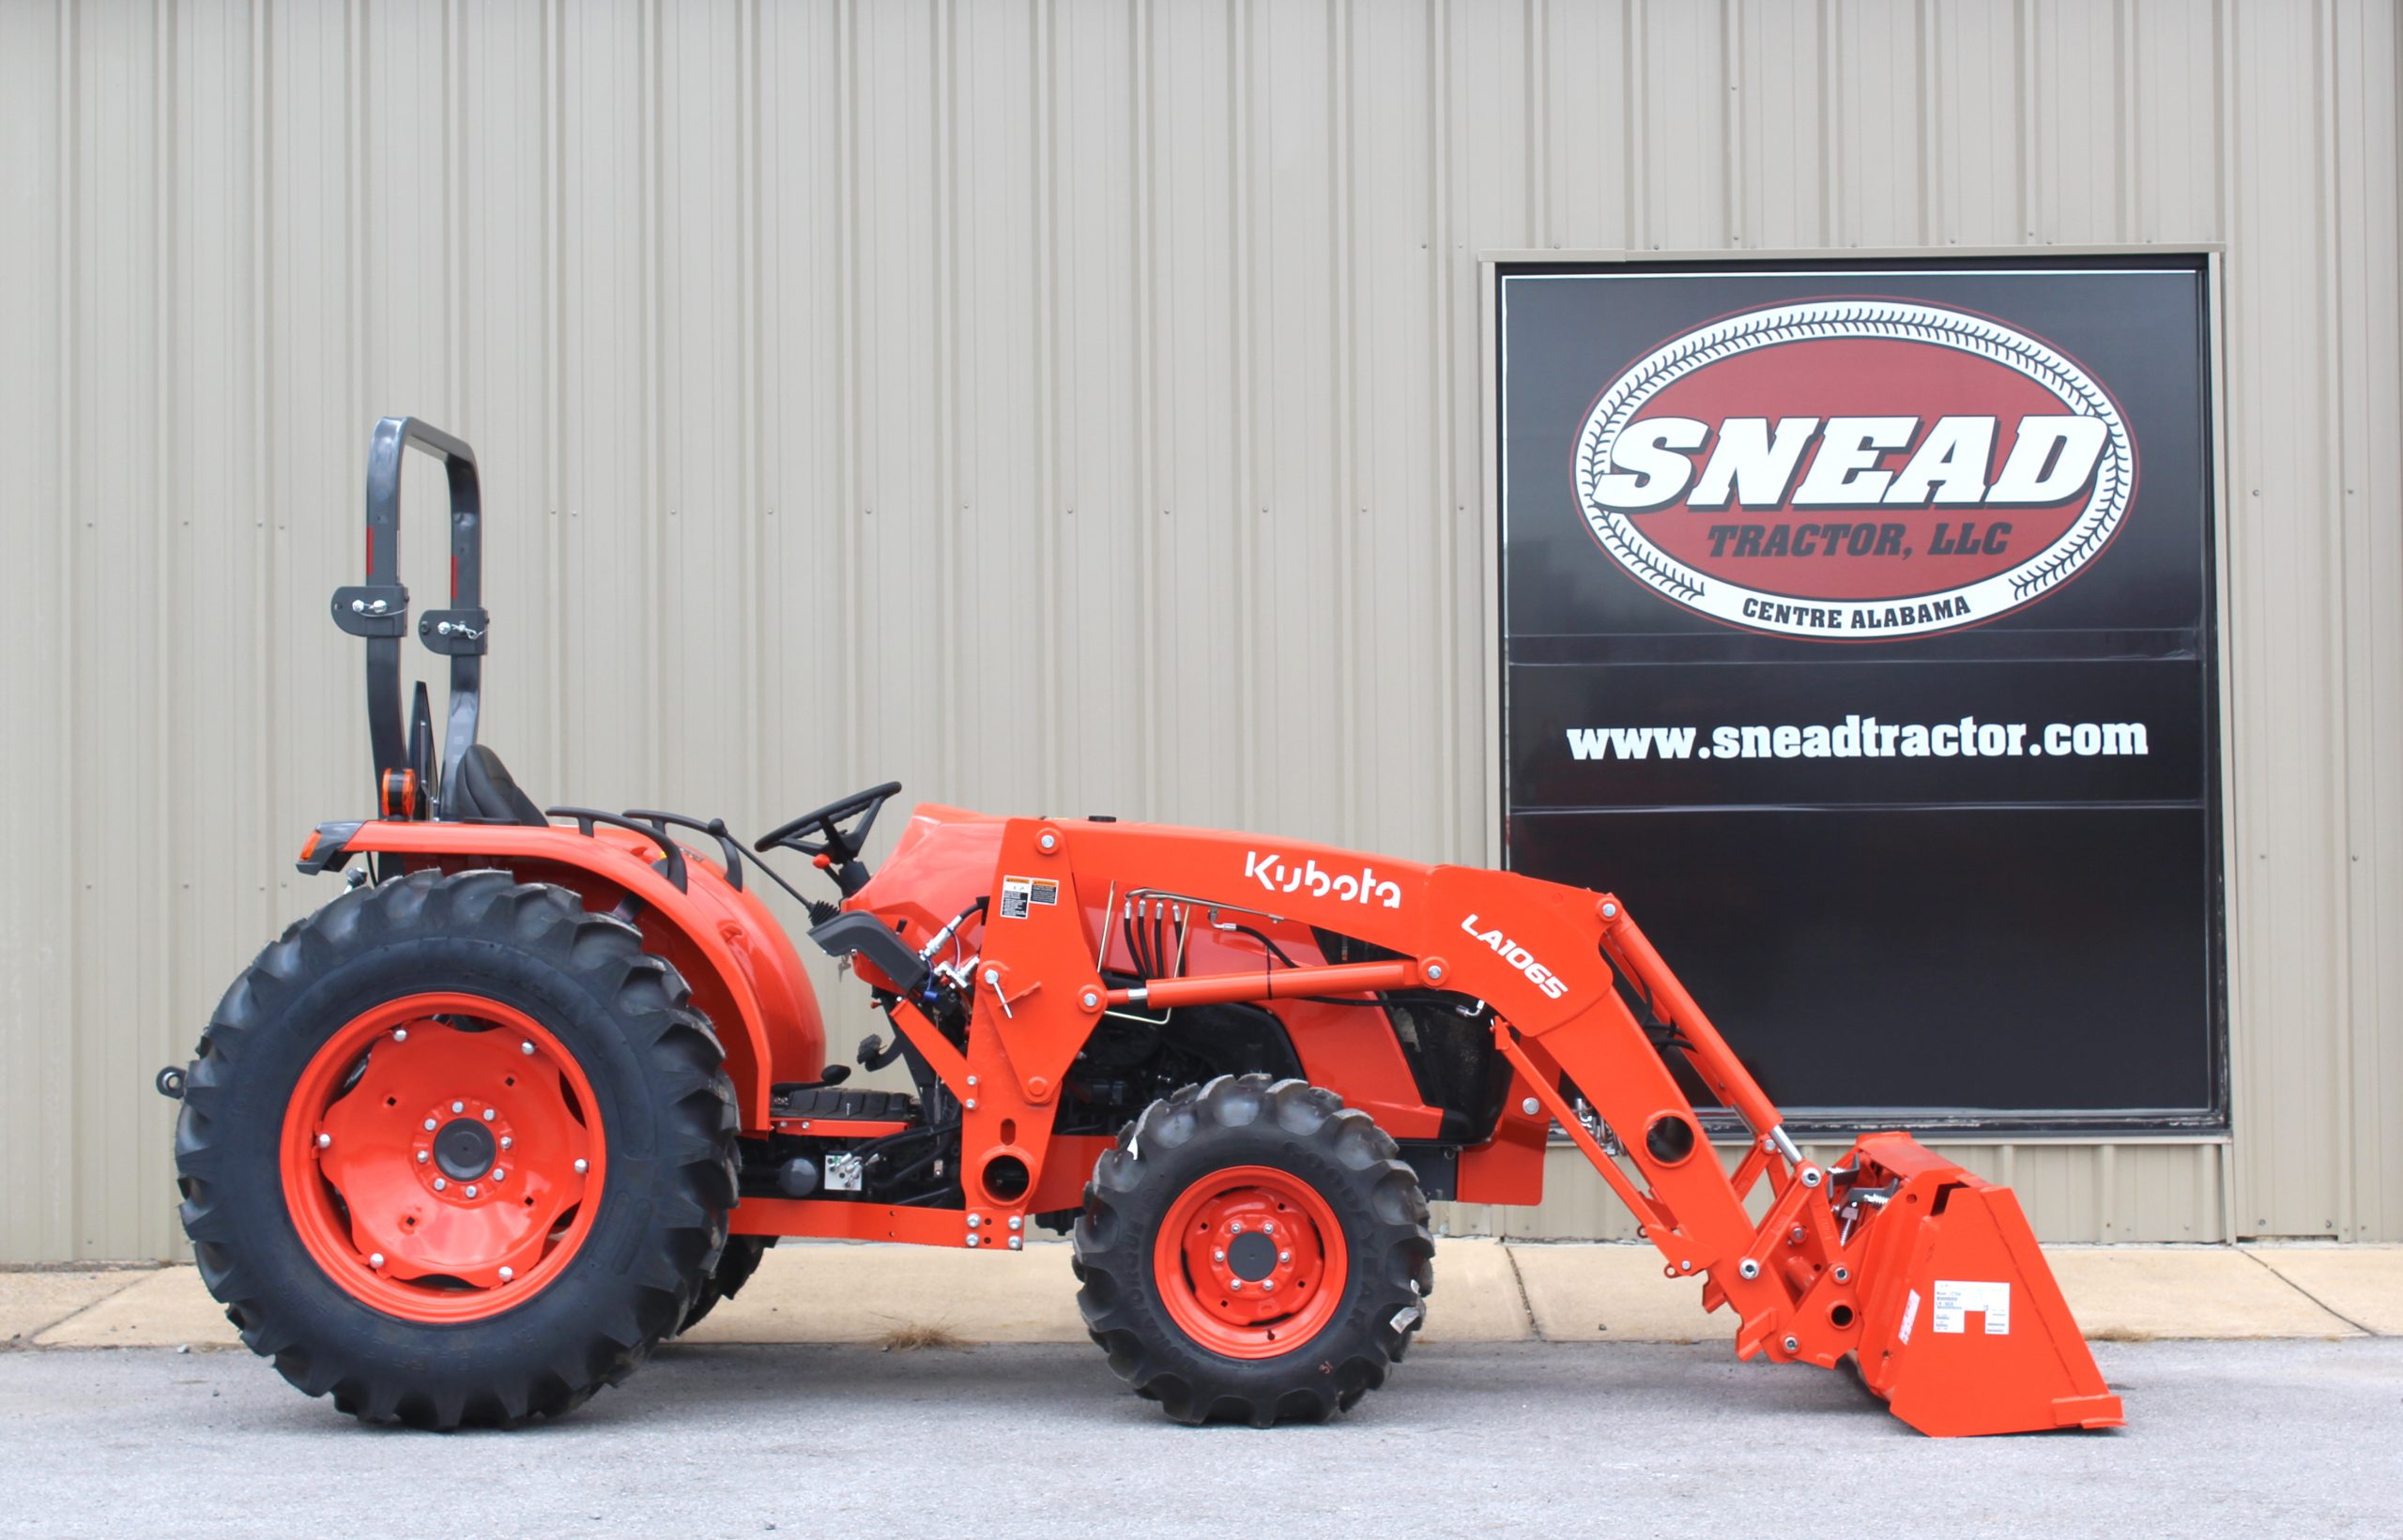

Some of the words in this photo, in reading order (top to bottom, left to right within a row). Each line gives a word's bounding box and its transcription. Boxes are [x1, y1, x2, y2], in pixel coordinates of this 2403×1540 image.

[1591, 415, 2108, 510] SNEAD
[1707, 523, 1913, 559] TRACTOR,
[1927, 522, 2013, 557] LLC
[1742, 597, 1843, 629] CENTRE
[1850, 595, 1971, 629] ALABAMA
[1566, 714, 2150, 761] www.sneadtractor.com
[1244, 850, 1401, 909] Kubota
[1461, 913, 1569, 999] LA1065
